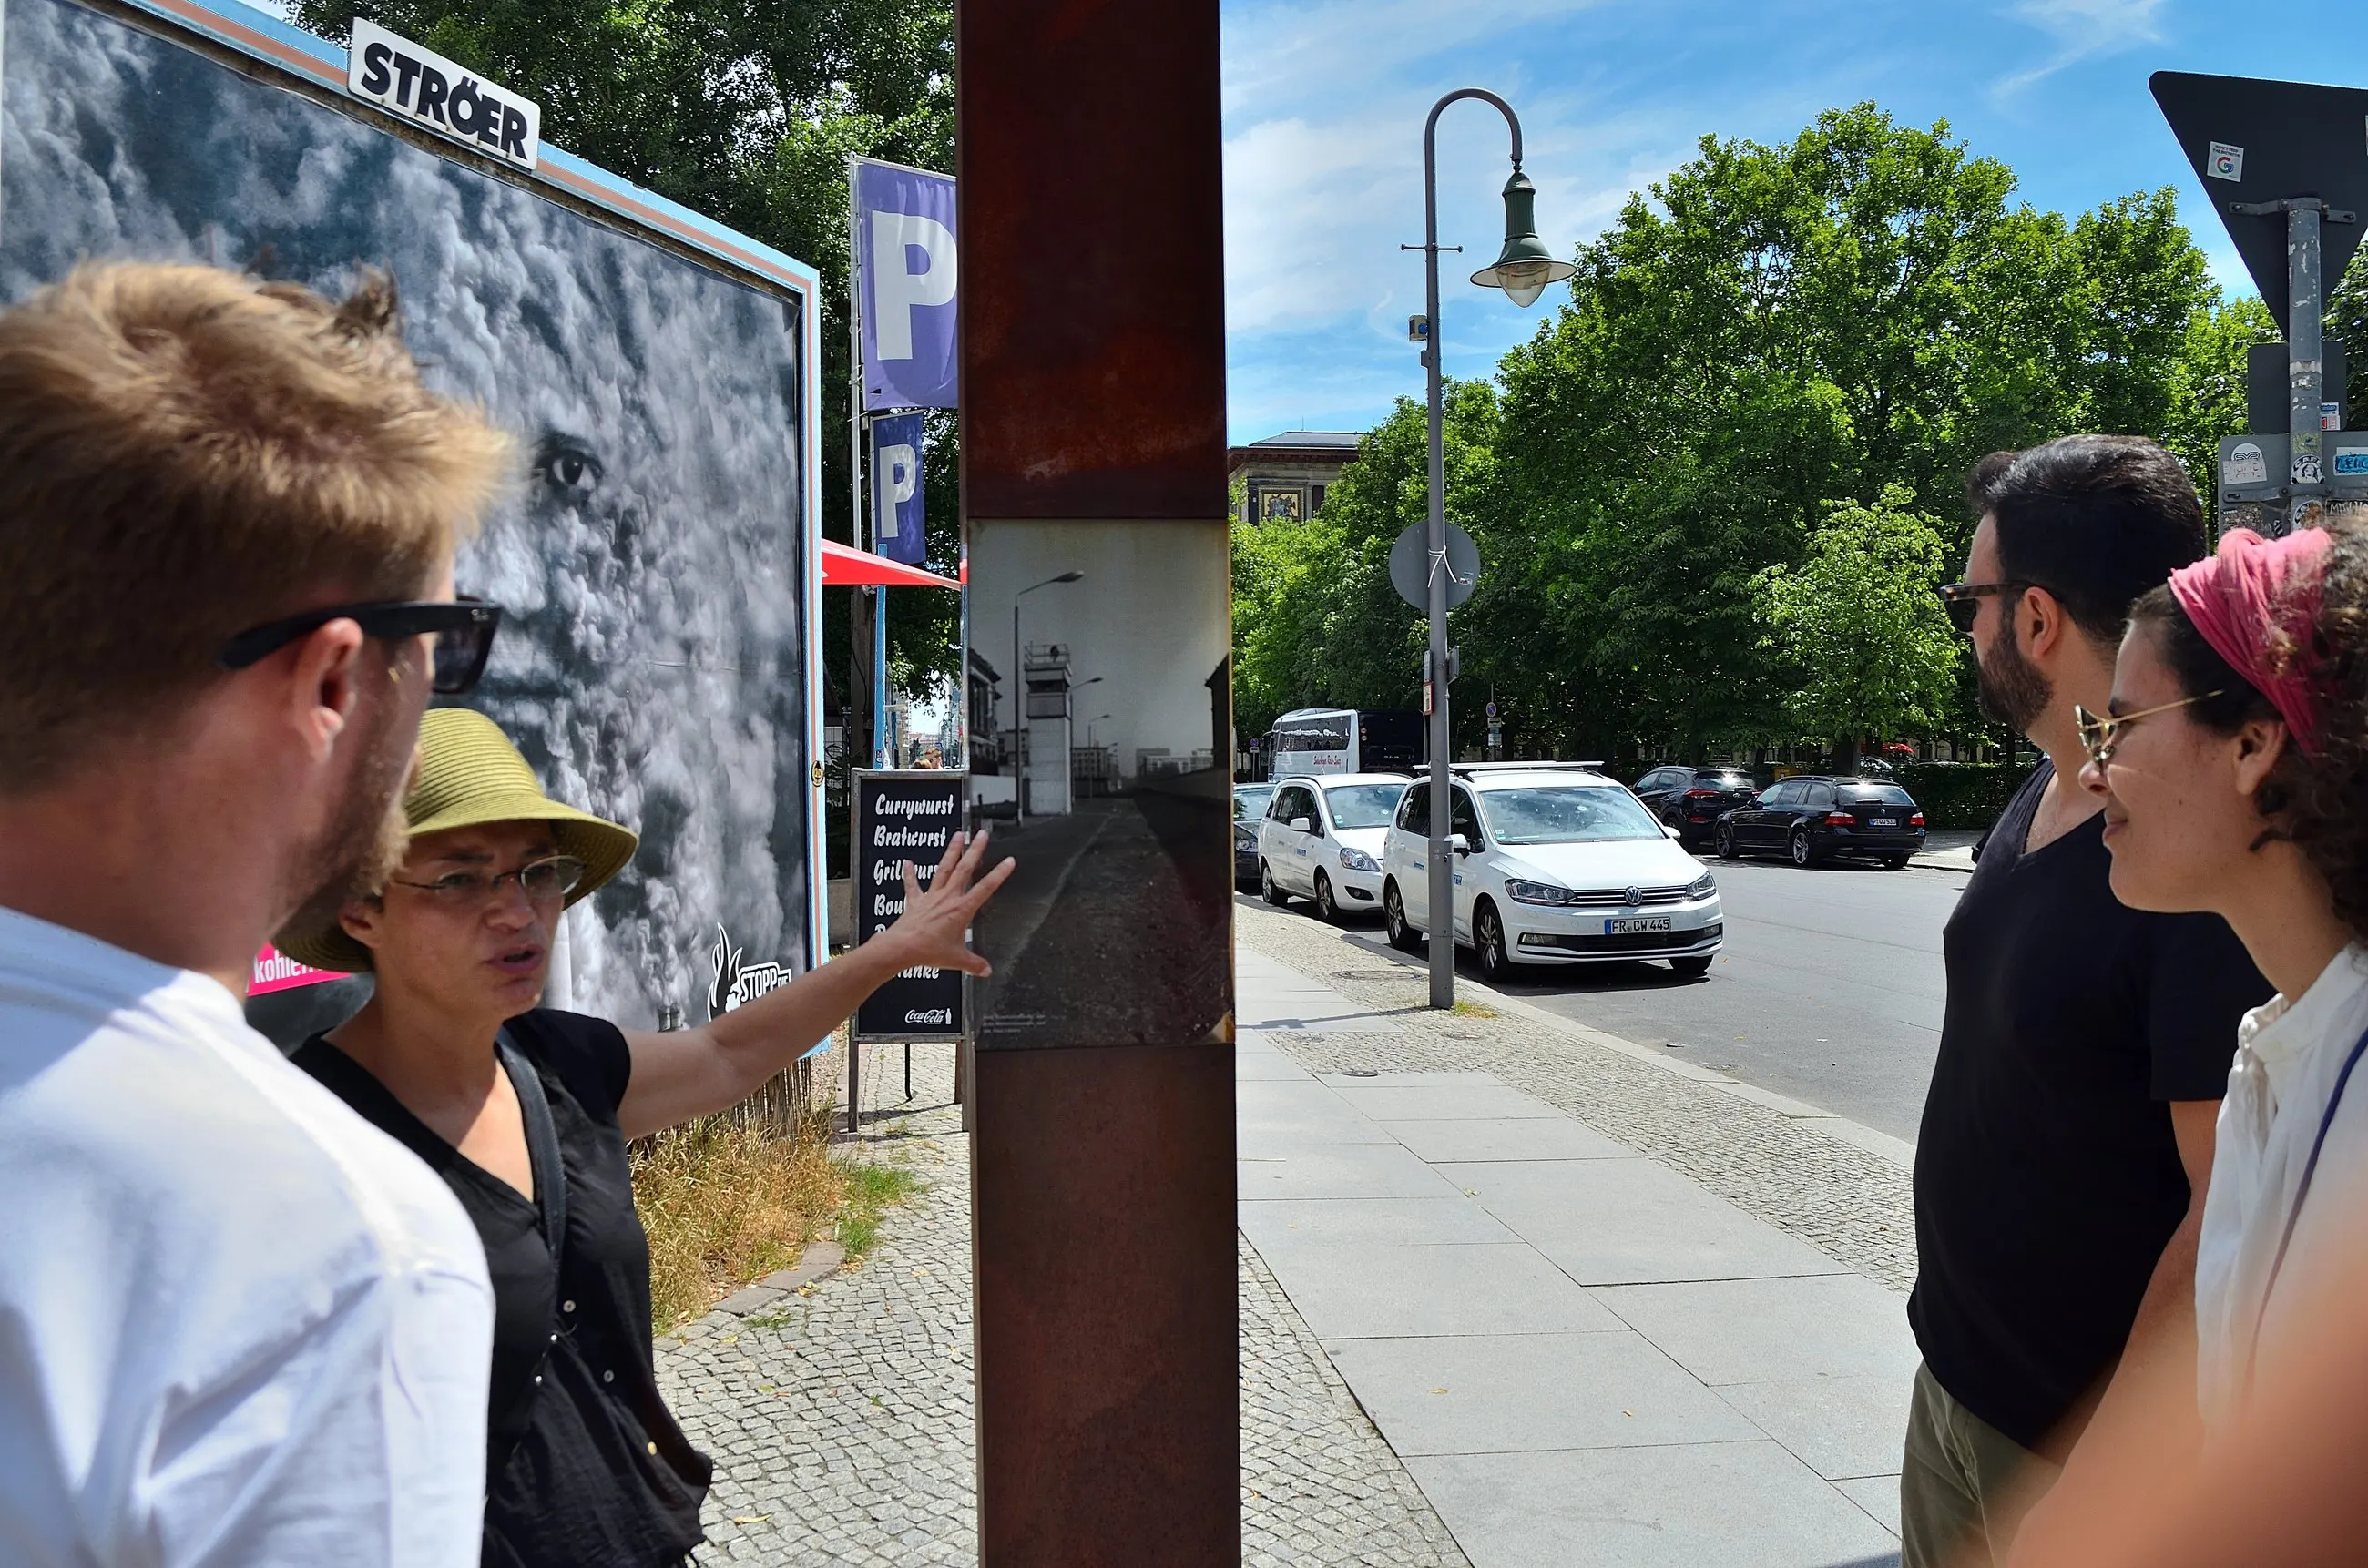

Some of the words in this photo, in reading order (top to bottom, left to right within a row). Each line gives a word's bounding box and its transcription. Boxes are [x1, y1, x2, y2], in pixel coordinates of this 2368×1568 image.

[361, 42, 527, 161] STRÖER
[872, 209, 958, 361] P
[880, 443, 916, 538] P
[875, 793, 954, 820] Currywurst
[873, 824, 946, 848] Bratwurst
[874, 893, 907, 916] Bou
[1612, 921, 1627, 932] FR
[1633, 920, 1648, 932] CW
[1649, 919, 1670, 931] 445
[740, 967, 779, 1003] STOPP
